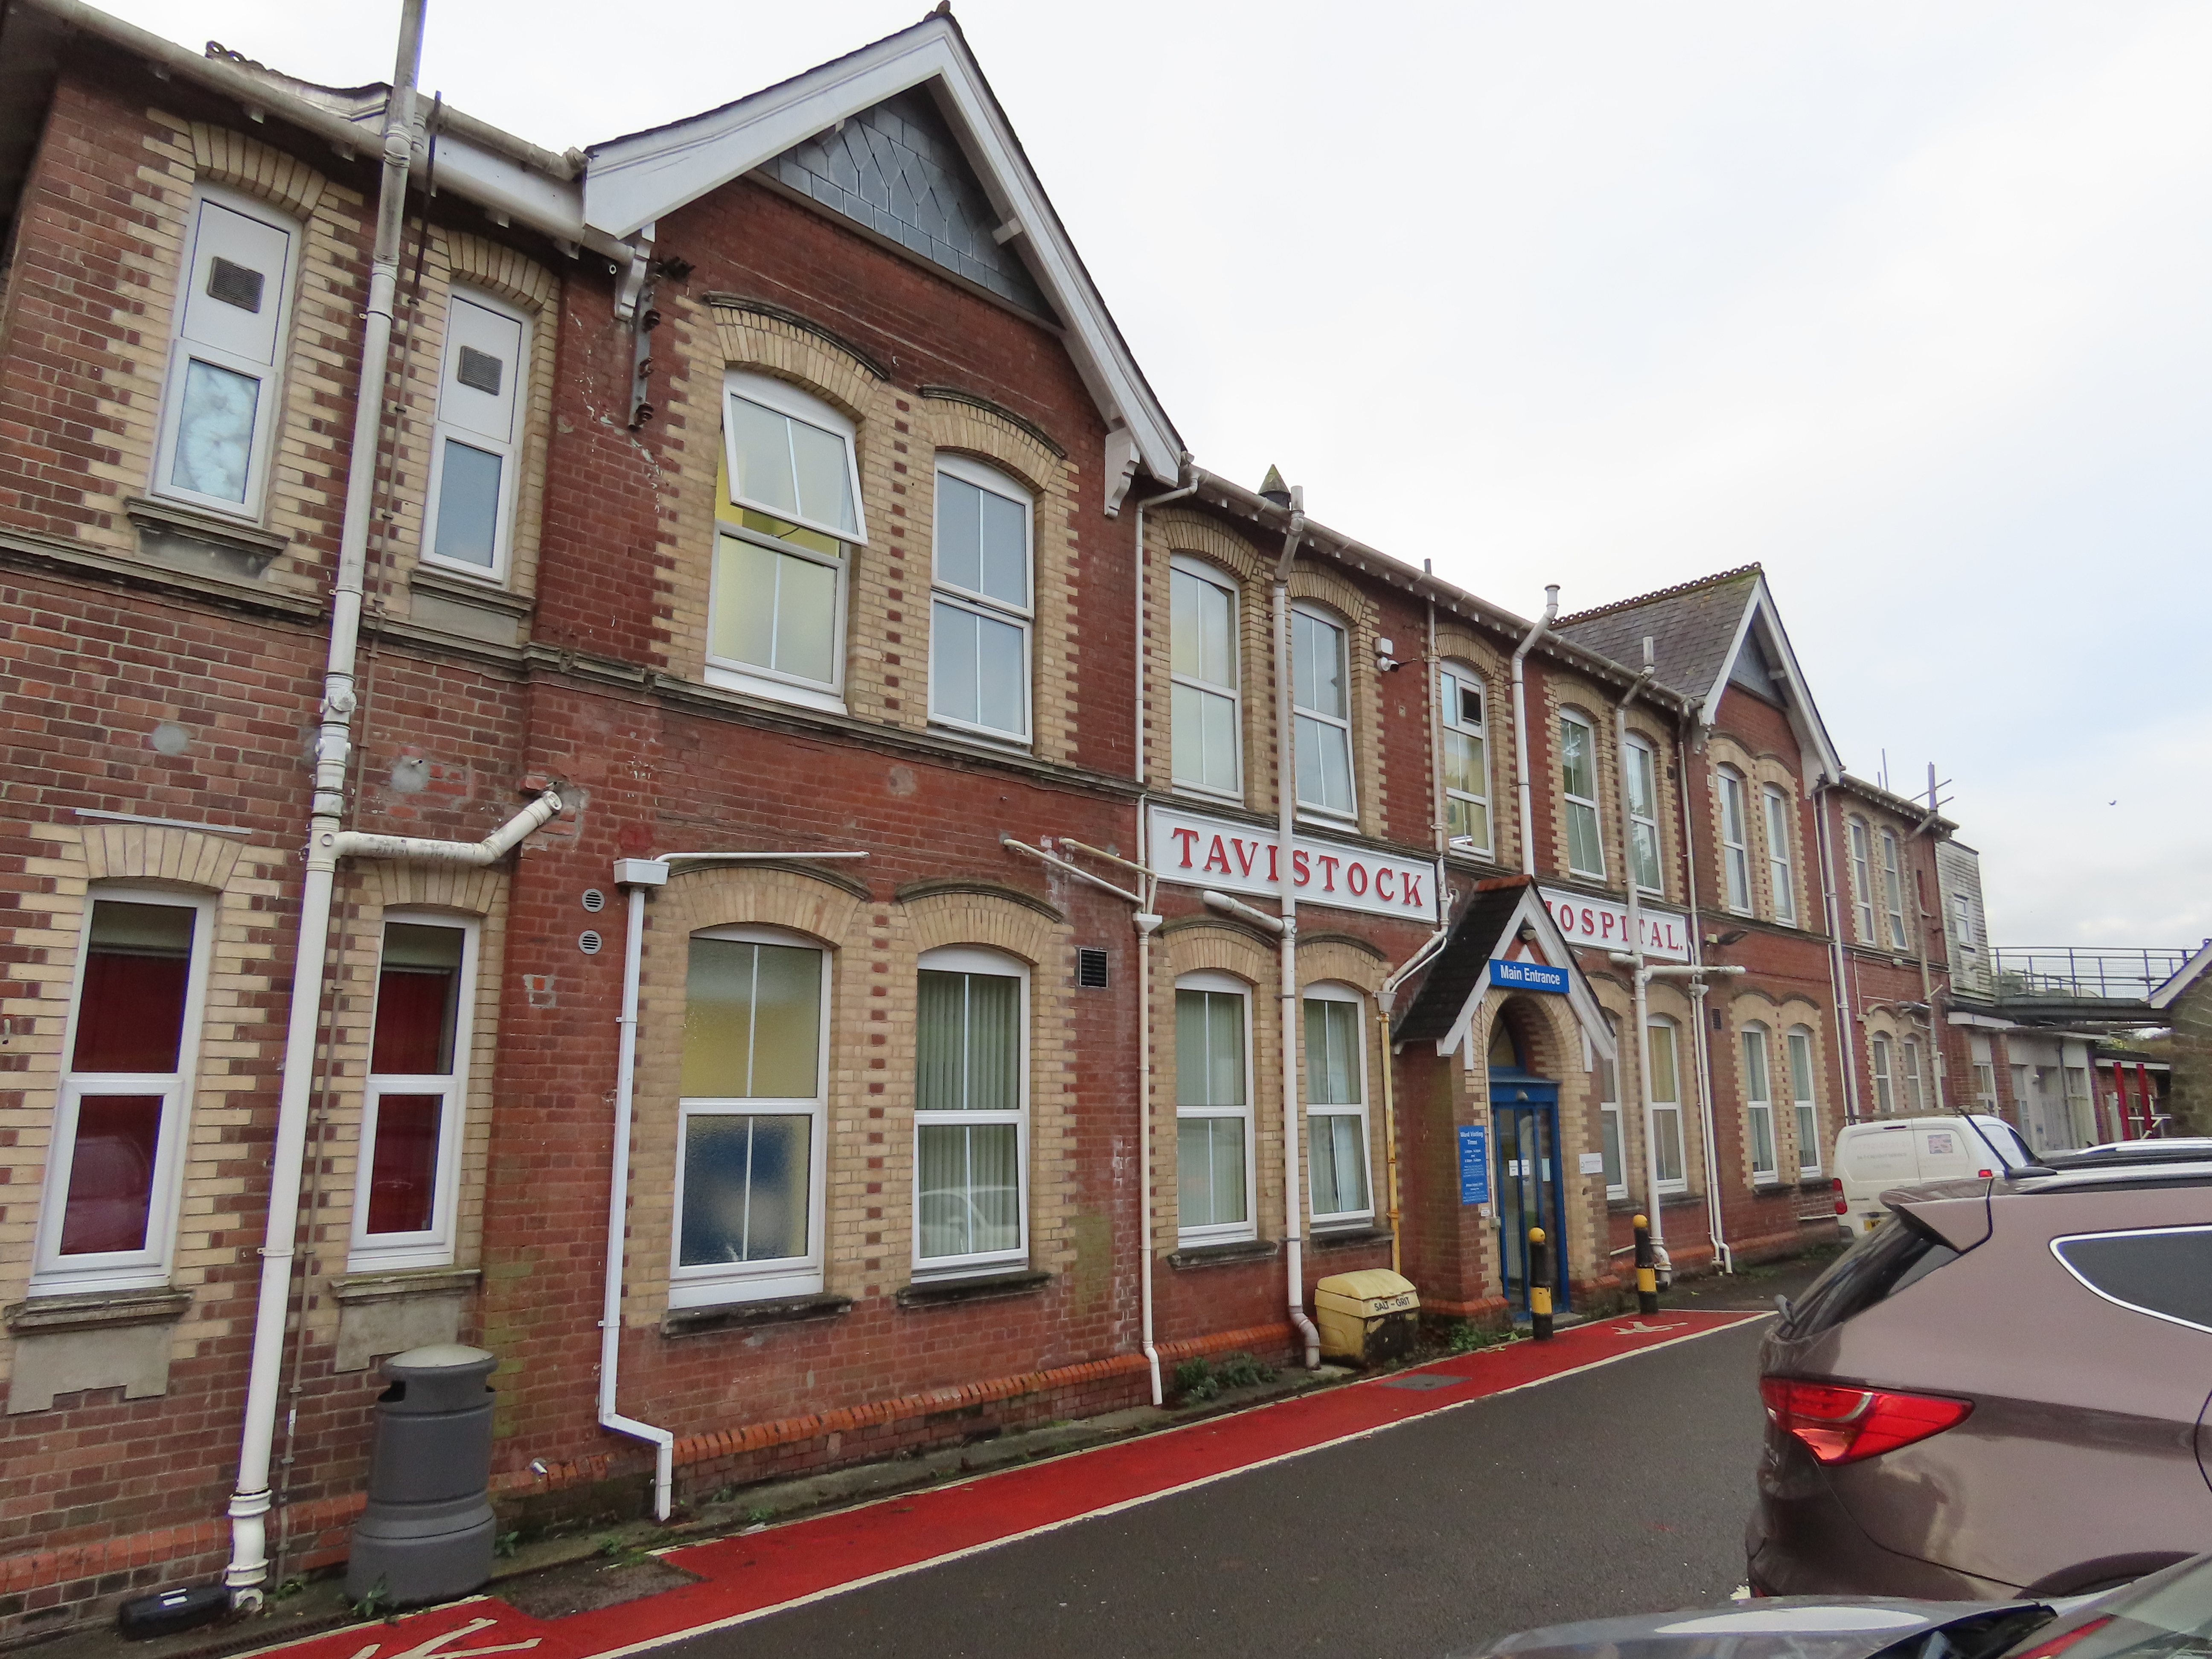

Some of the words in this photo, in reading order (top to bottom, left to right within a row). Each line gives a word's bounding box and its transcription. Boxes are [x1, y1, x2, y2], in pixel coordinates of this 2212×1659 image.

[1172, 827, 1423, 907] TAVISTOCK
[1544, 900, 1683, 950] OSPITAL.
[1500, 964, 1522, 980] Main
[1524, 967, 1560, 985] Entrance
[1374, 1301, 1389, 1311] SALT
[1396, 1297, 1410, 1307] GRIT
